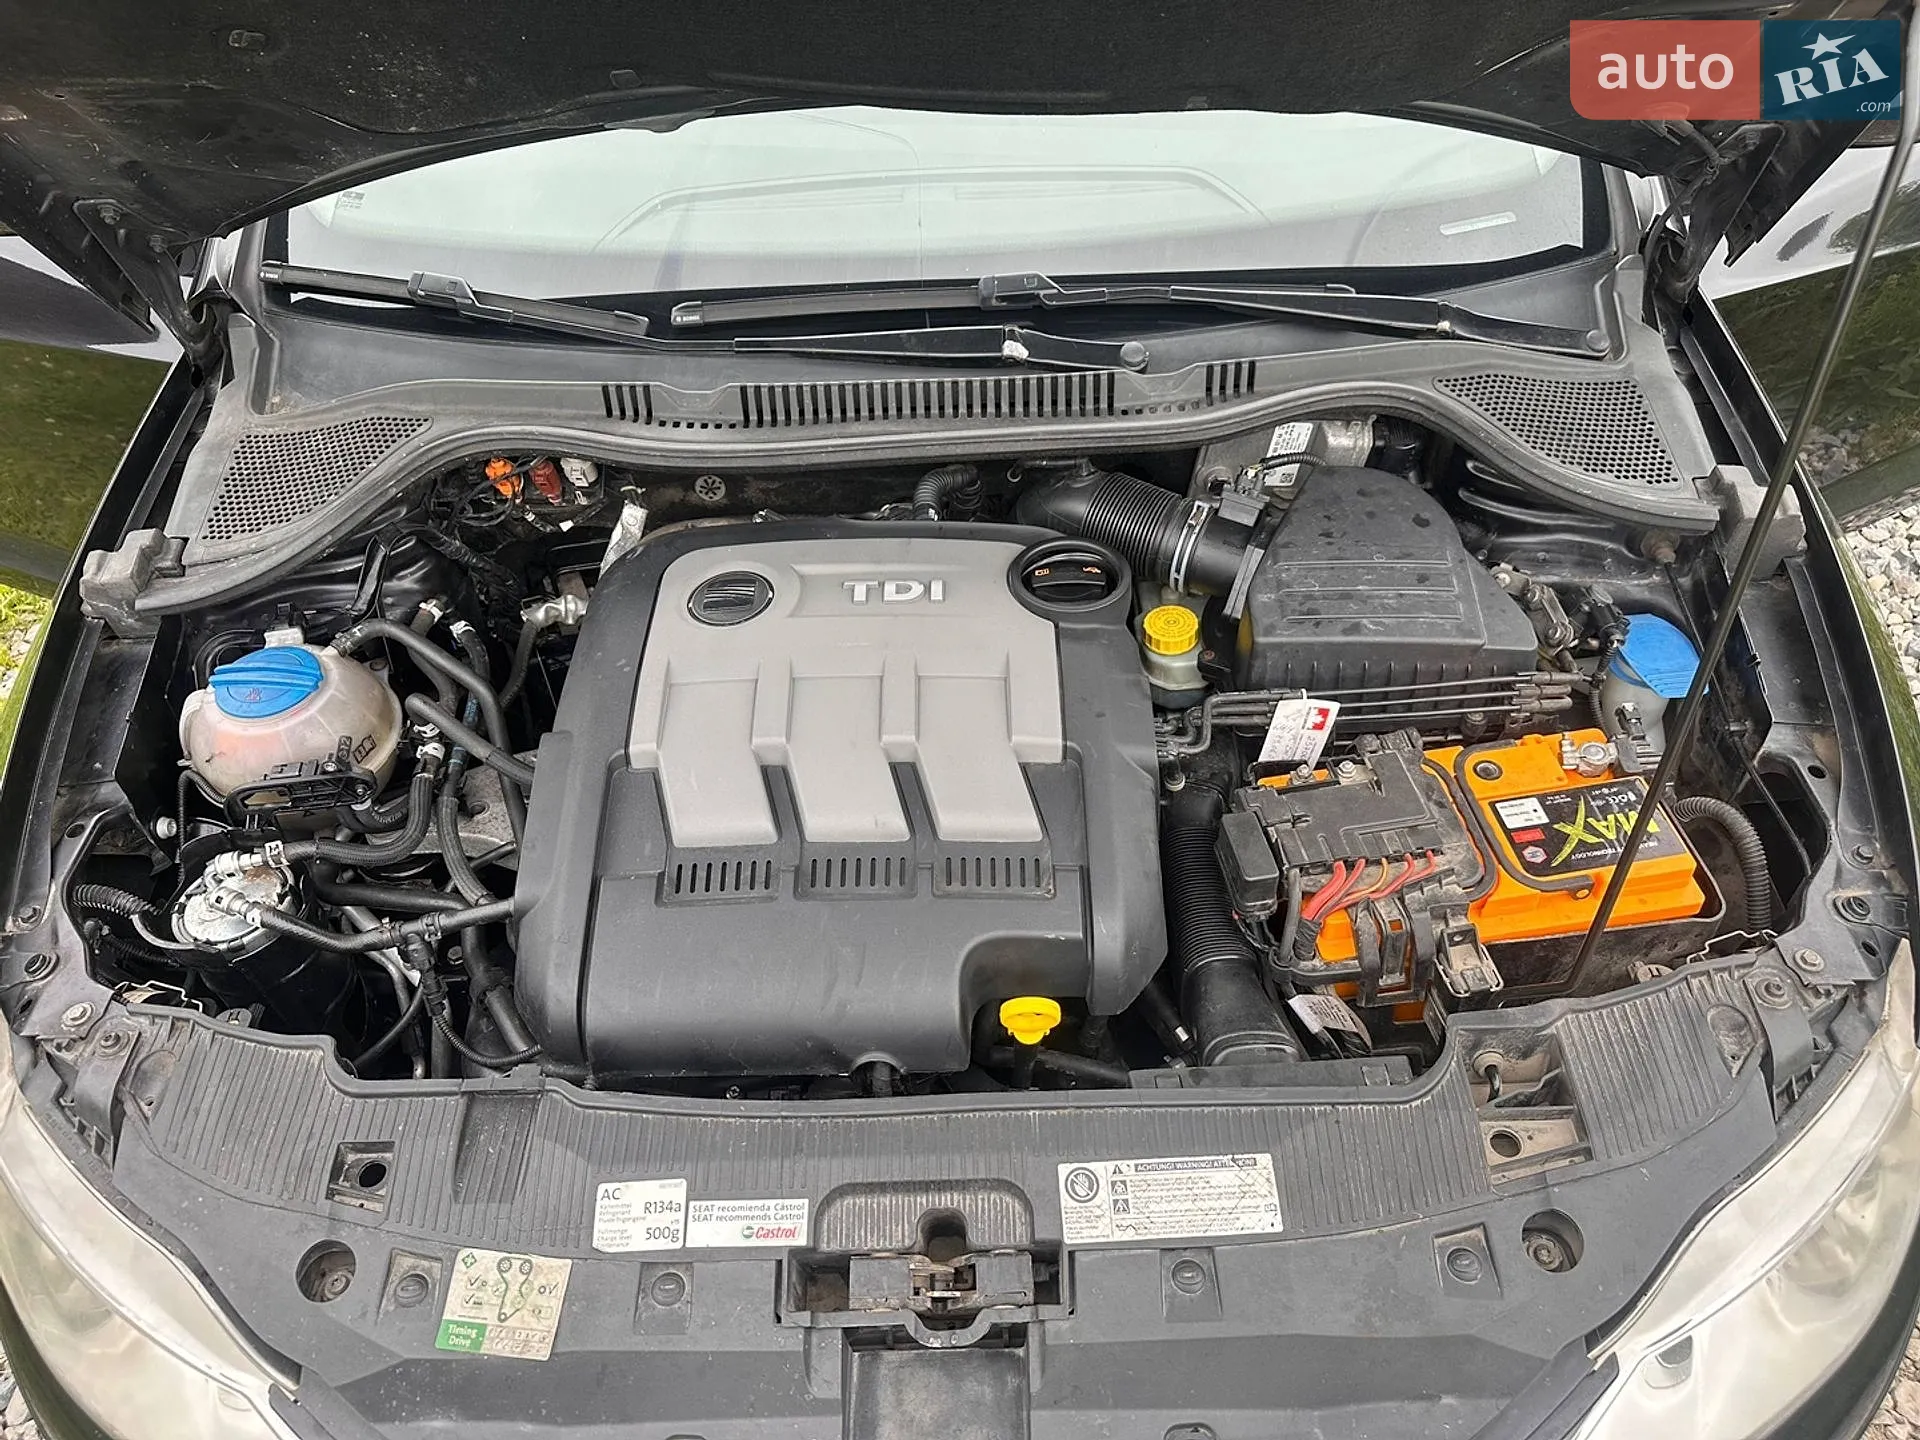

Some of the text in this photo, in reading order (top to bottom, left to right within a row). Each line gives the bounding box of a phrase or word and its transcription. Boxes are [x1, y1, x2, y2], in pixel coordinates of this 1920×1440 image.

[842, 579, 945, 604] TDI
[600, 1187, 622, 1200] AC
[643, 1200, 682, 1215] R134a
[692, 1204, 716, 1213] SEAT
[717, 1203, 771, 1212] recomienda
[691, 1212, 805, 1222] SEAT recommends Castrol
[645, 1226, 680, 1243] 500g
[755, 1226, 798, 1239] Castrol
[448, 1323, 478, 1339] Timing
